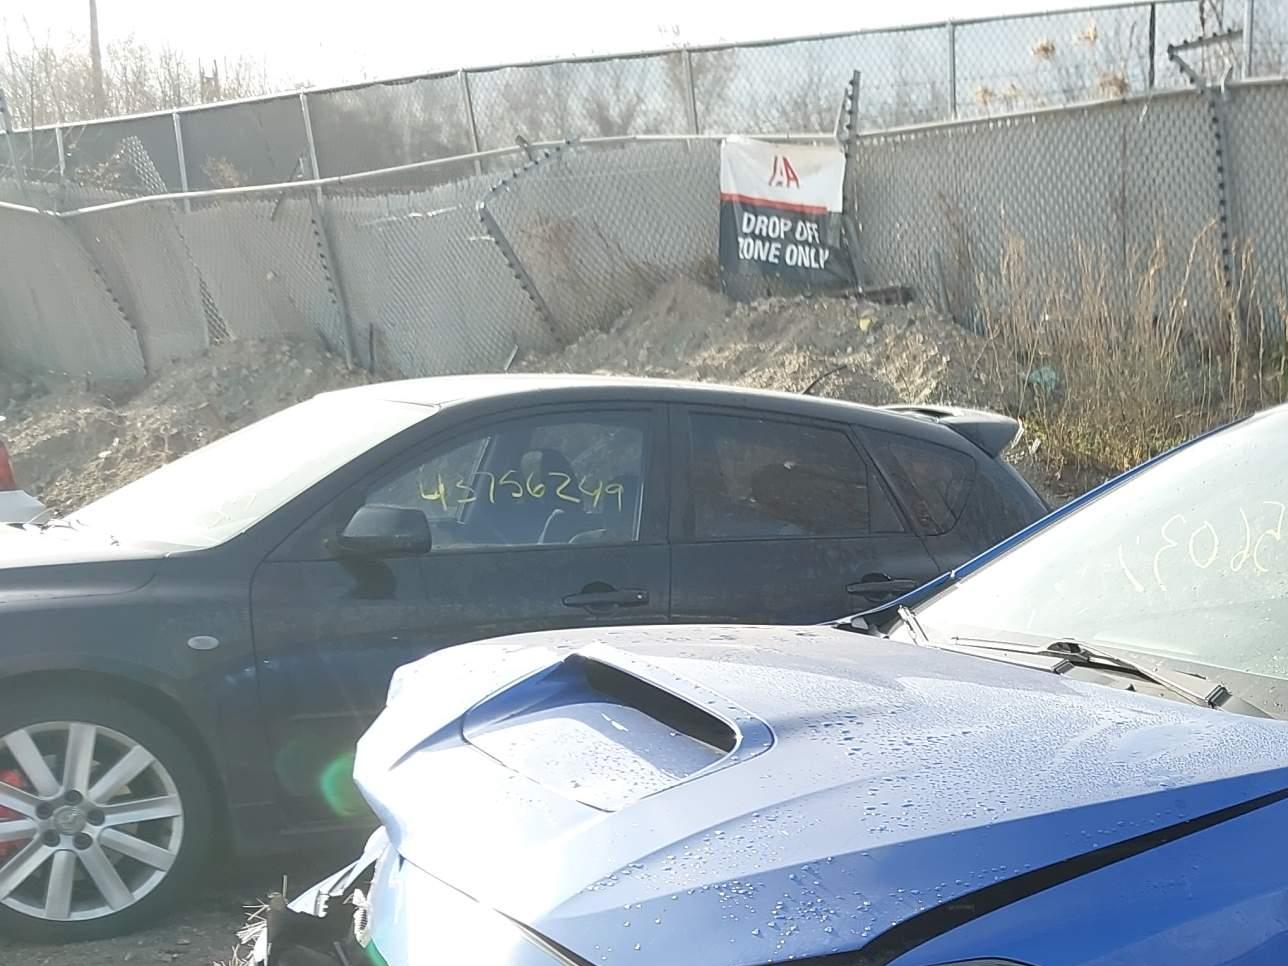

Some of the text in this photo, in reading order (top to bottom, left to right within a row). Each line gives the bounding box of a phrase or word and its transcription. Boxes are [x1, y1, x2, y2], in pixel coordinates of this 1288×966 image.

[742, 211, 820, 244] DROP OFF
[738, 235, 829, 270] ZONE ONLY
